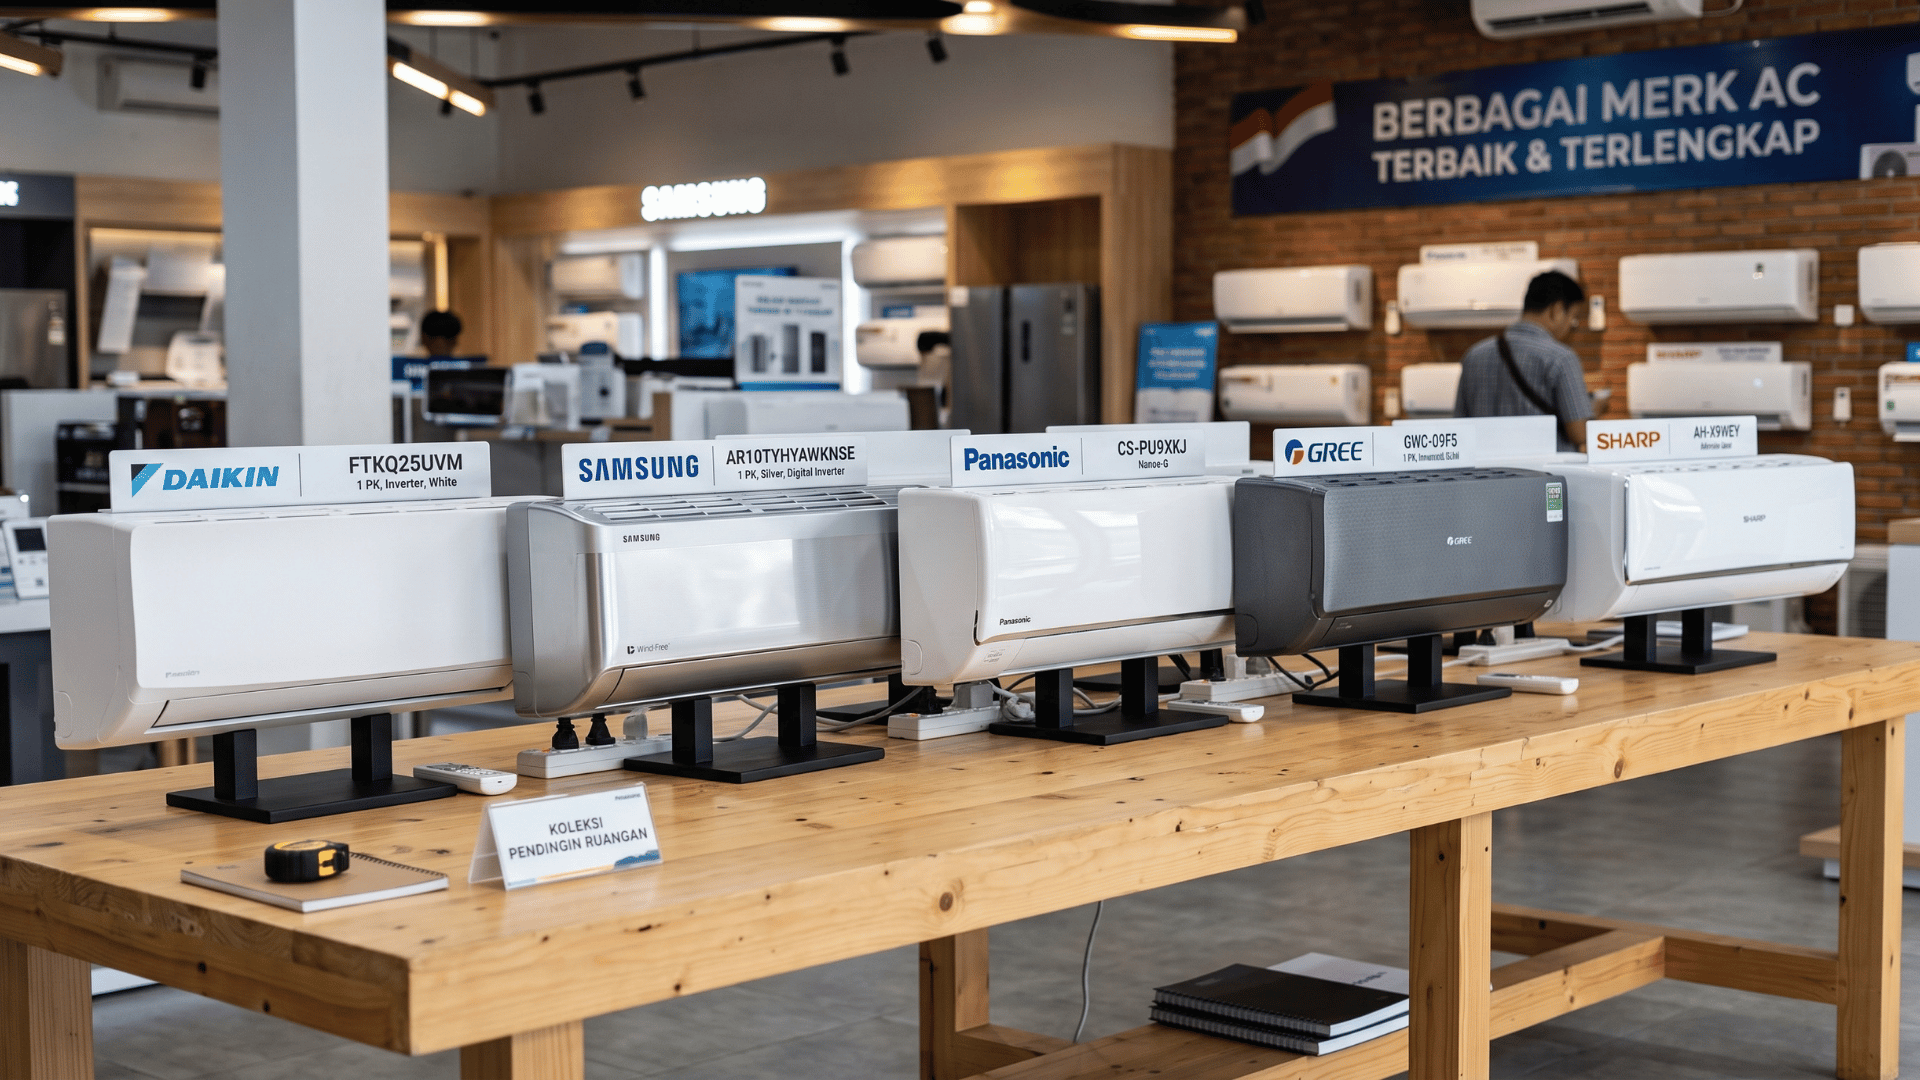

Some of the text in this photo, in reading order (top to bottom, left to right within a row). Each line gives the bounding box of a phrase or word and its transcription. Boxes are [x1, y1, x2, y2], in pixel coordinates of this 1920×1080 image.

[1373, 62, 1821, 142] BERBAGAI MERK AC
[1372, 119, 1821, 183] TERBAIK & TERLENGKAP
[1404, 433, 1457, 449] GWC-09F5
[1597, 431, 1661, 450] SHARP
[1694, 424, 1740, 439] AH-X9WEY
[726, 446, 855, 465] AR10TYHYAWKNSE
[1117, 439, 1187, 456] CS-PU9XKJ
[1308, 441, 1363, 462] GREE
[349, 453, 463, 474] FTKQ25UVM
[964, 446, 1070, 471] Panasonic
[1138, 459, 1169, 469] Nanoe-G
[162, 466, 279, 490] DAIKIN
[579, 455, 699, 482] SAMSUNG
[738, 467, 845, 481] 1 PK, Silver, Digital Inverter
[357, 477, 458, 492] 1 PK, Inverter, White
[623, 533, 660, 543] SAMSUNG
[1454, 536, 1473, 545] GREE
[999, 615, 1031, 625] Panasonic
[549, 816, 604, 836] KOLEKSI
[509, 827, 648, 859] PENDINGIN RUANGAN
